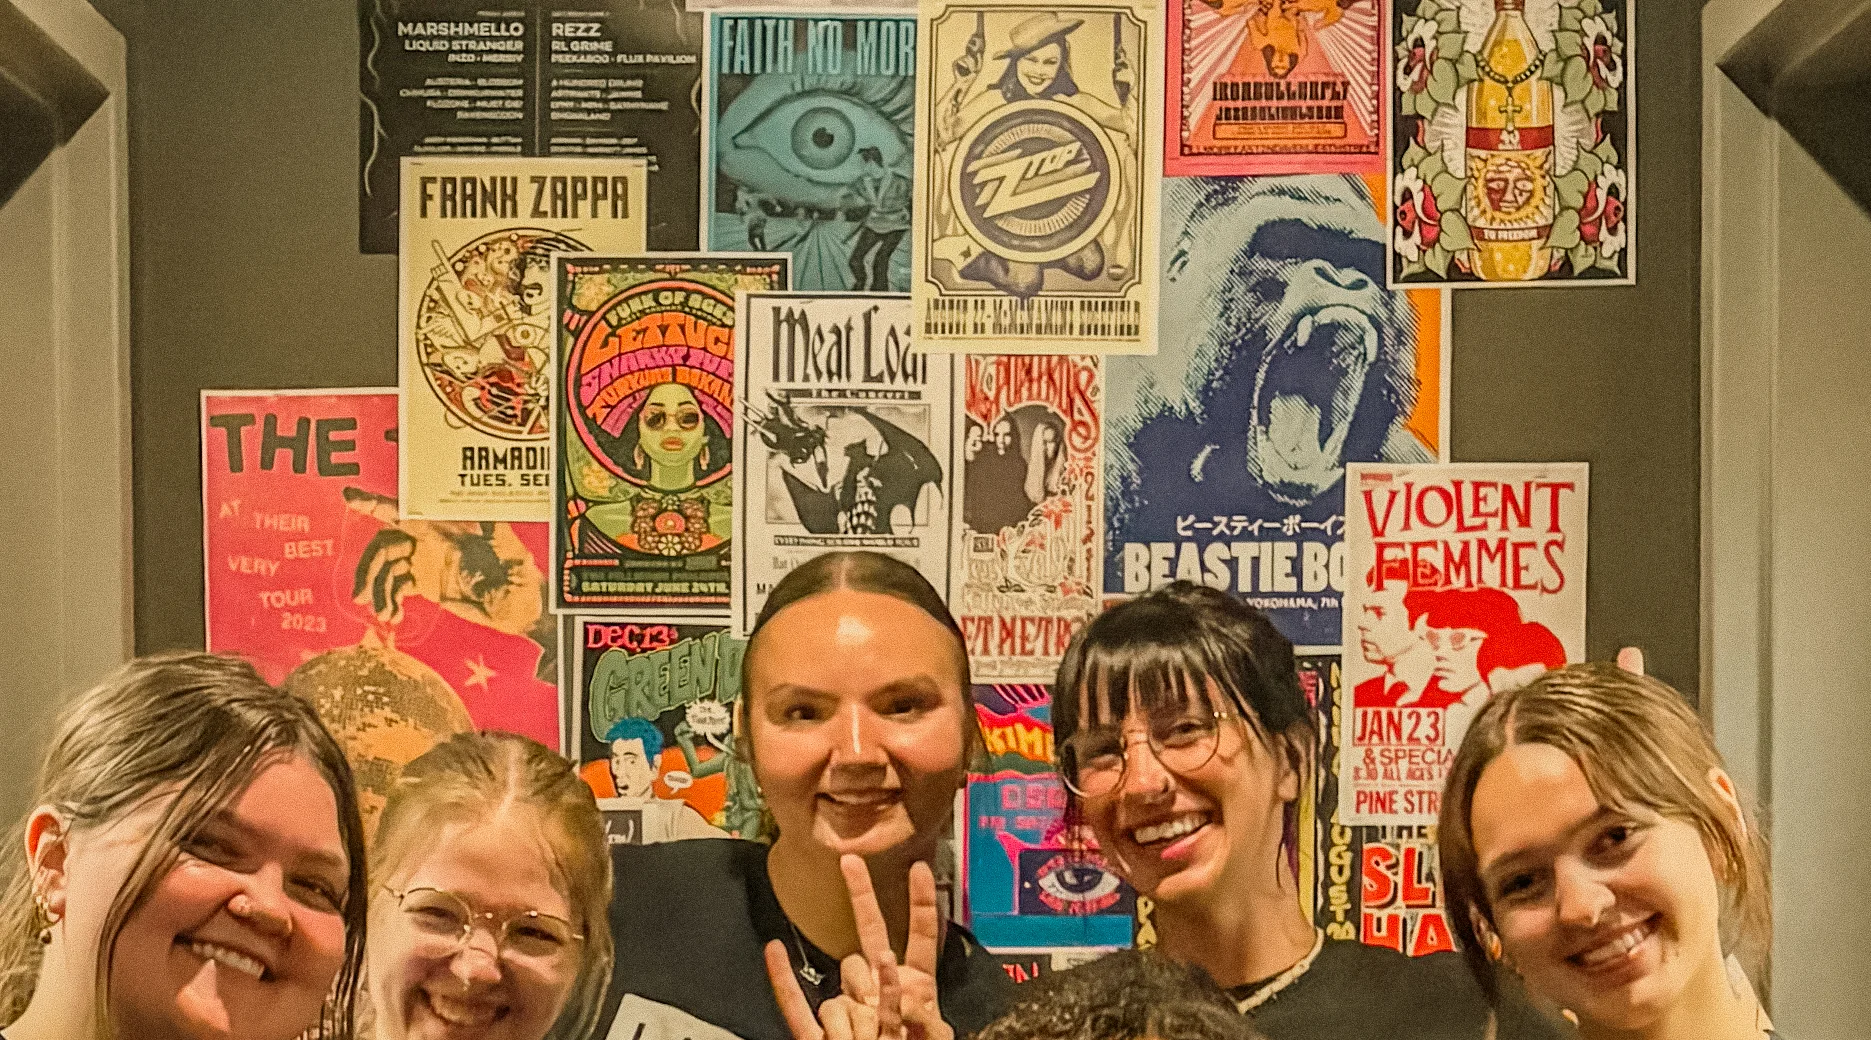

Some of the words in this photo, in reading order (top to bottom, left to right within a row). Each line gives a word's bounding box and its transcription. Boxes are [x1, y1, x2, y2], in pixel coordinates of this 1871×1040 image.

[397, 22, 525, 36] MARSHMELLO
[551, 22, 602, 37] REZZ
[404, 40, 450, 51] LIQUID
[451, 40, 524, 51] STRANGER
[721, 19, 794, 74] FAITH
[807, 20, 843, 74] NO
[419, 176, 518, 219] FRANK
[529, 176, 629, 219] ZAPPA
[581, 311, 735, 373] LETTUC
[772, 306, 853, 383] Meat
[208, 413, 360, 477] THE
[461, 446, 550, 471] ARMADI
[457, 473, 512, 487] TUES.
[218, 499, 242, 519] AT
[1362, 479, 1575, 538] VIOLENT
[253, 511, 310, 533] THEIR
[1176, 514, 1345, 537] ビースティーボーイ
[283, 539, 334, 560] BEST
[227, 556, 281, 578] VERY
[1124, 541, 1298, 593] BEASTIE
[1373, 537, 1566, 594] FEMMES
[258, 588, 313, 610] TOUR
[281, 612, 328, 633] 2023
[590, 631, 718, 743] GREEN
[1356, 710, 1402, 744] JAN
[1406, 710, 1441, 744] 23
[1362, 748, 1377, 765] &
[1355, 789, 1399, 815] PINE
